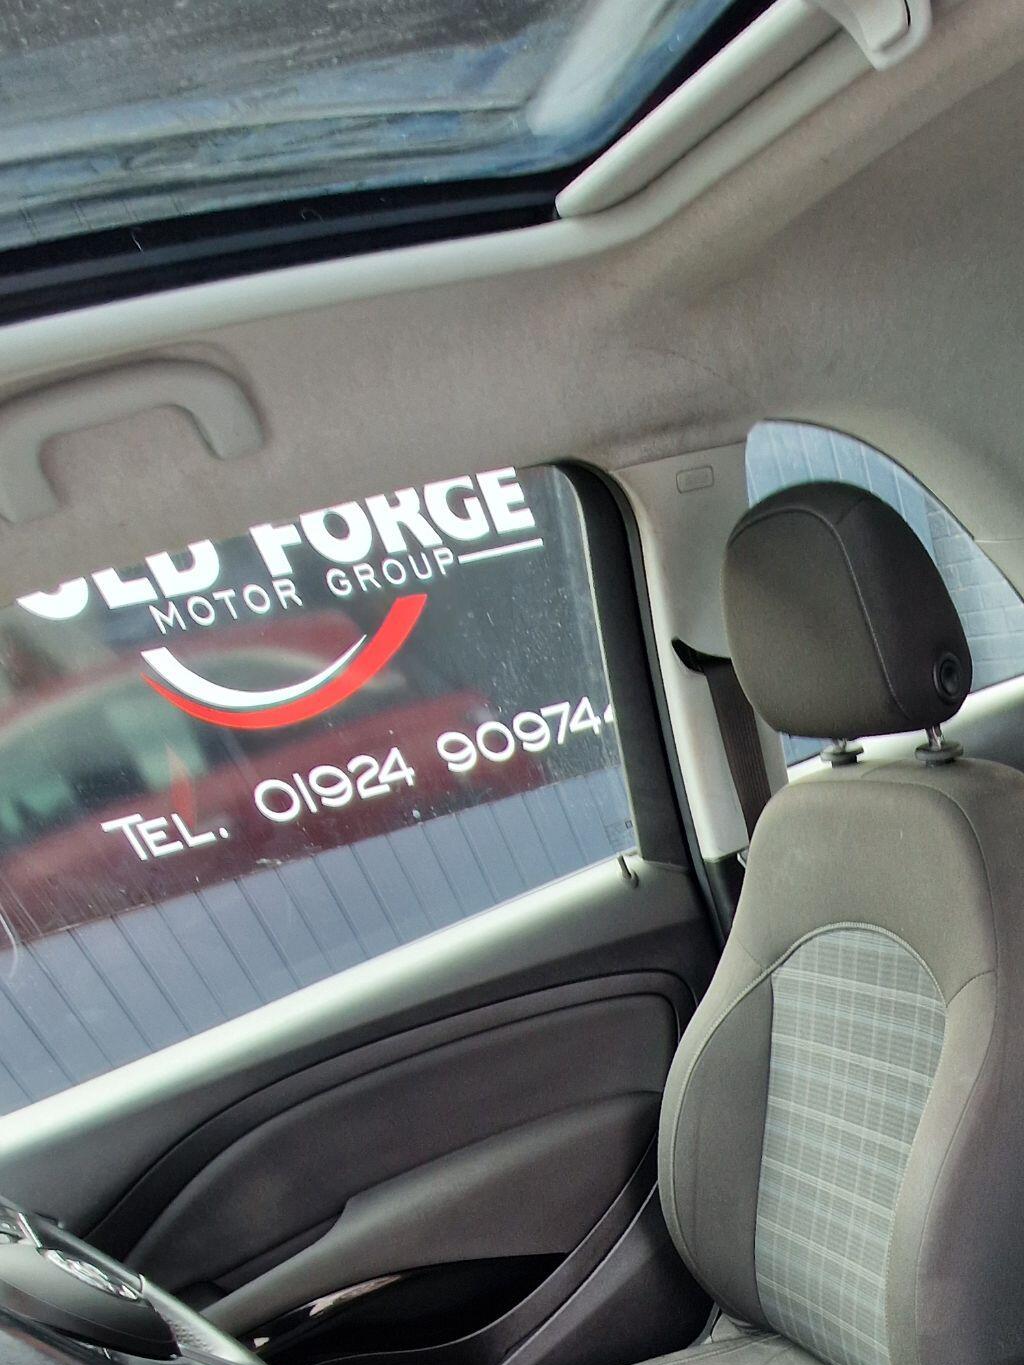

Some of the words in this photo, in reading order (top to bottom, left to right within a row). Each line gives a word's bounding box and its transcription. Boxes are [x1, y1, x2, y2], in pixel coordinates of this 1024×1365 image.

[248, 466, 537, 578] FORGE
[149, 578, 304, 635] MOTOR
[325, 546, 455, 598] GROUP
[254, 747, 416, 825] 01924
